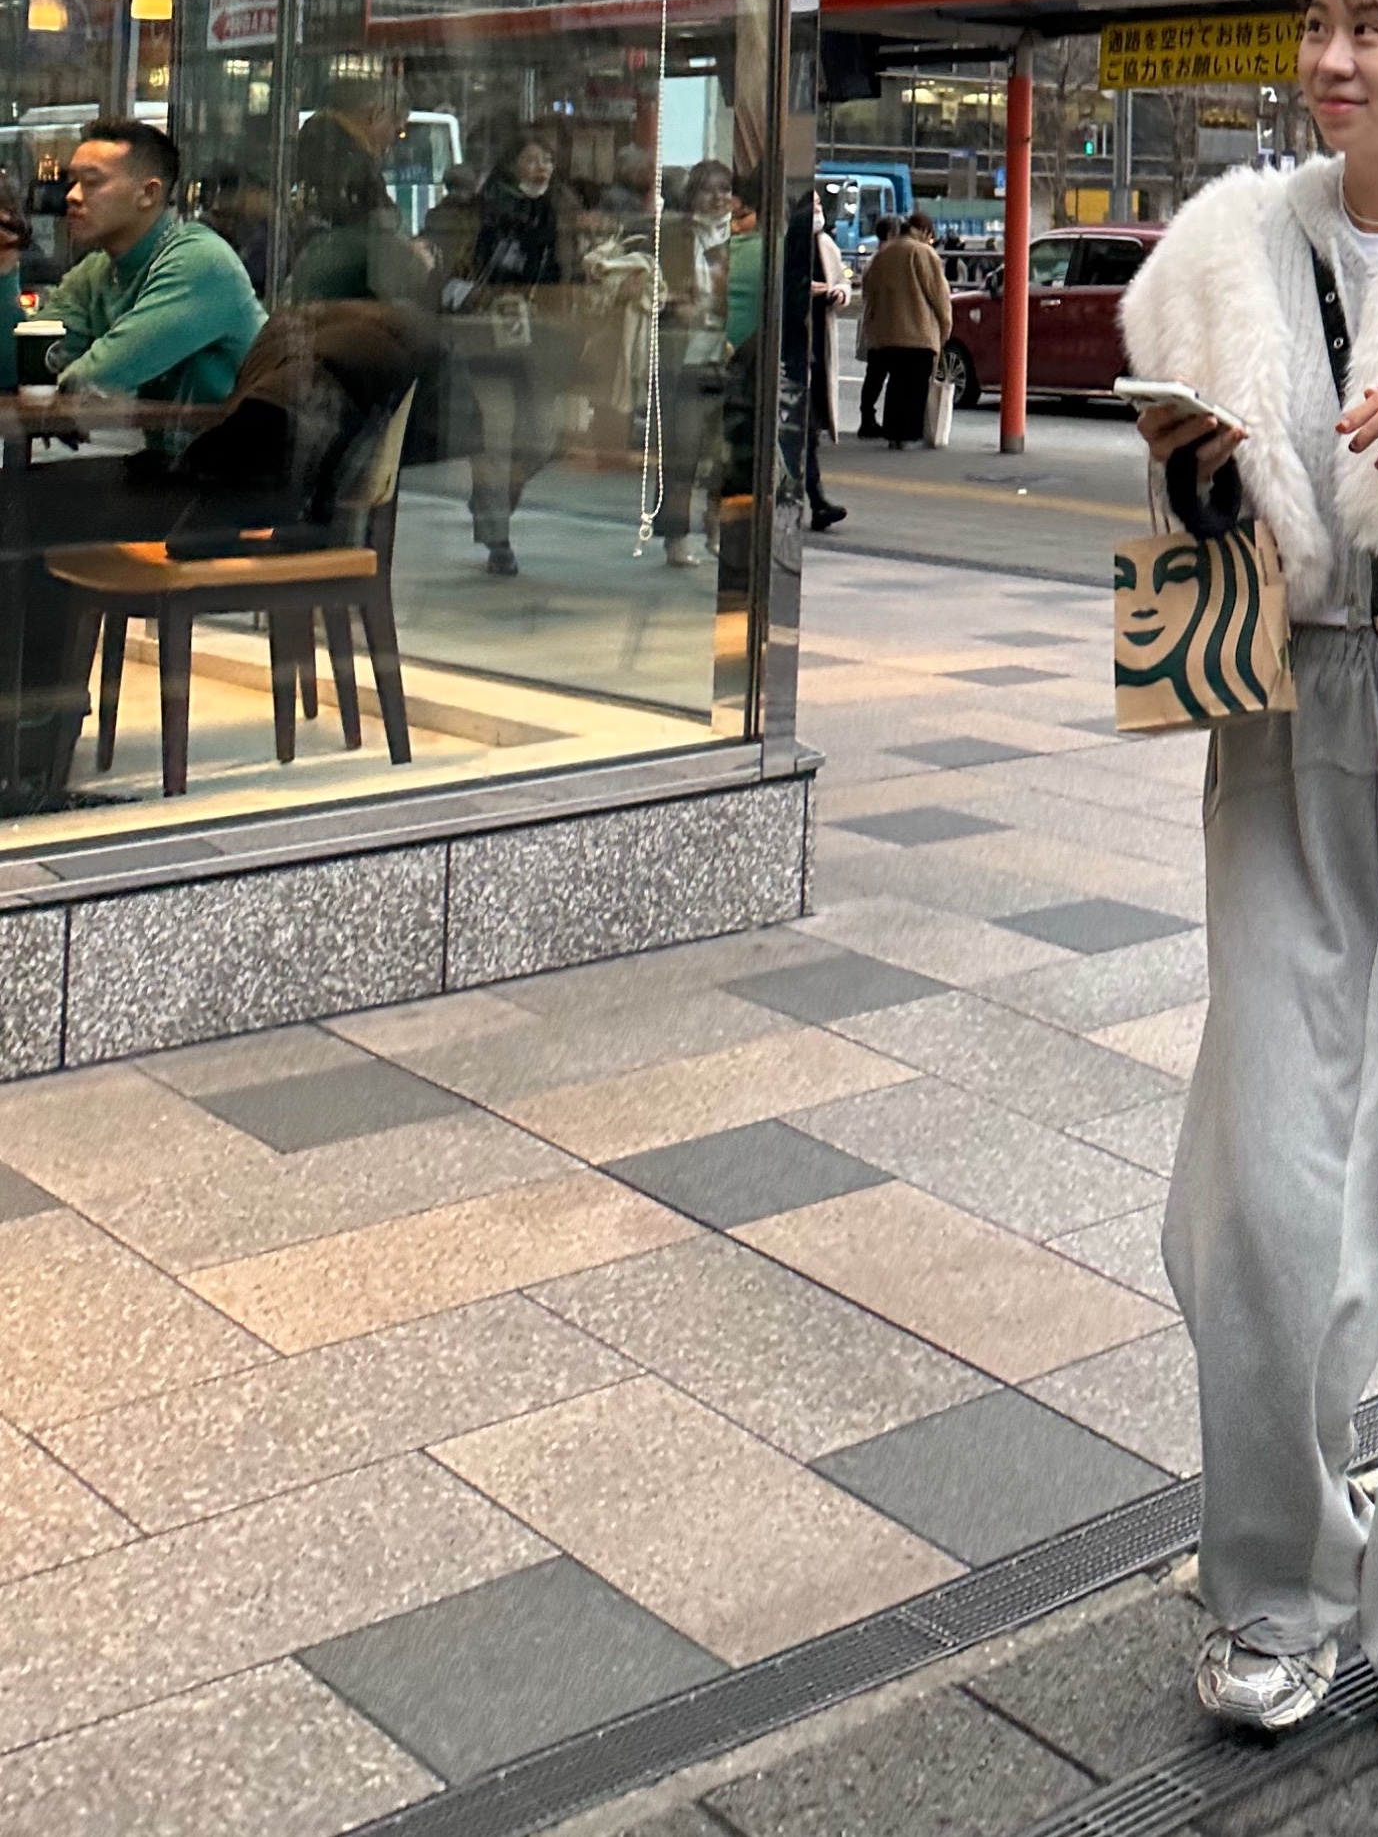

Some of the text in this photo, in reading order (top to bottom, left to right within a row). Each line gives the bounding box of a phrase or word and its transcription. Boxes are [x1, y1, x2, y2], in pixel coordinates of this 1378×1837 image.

[1106, 50, 1299, 83] ご協力をお願いいたし
